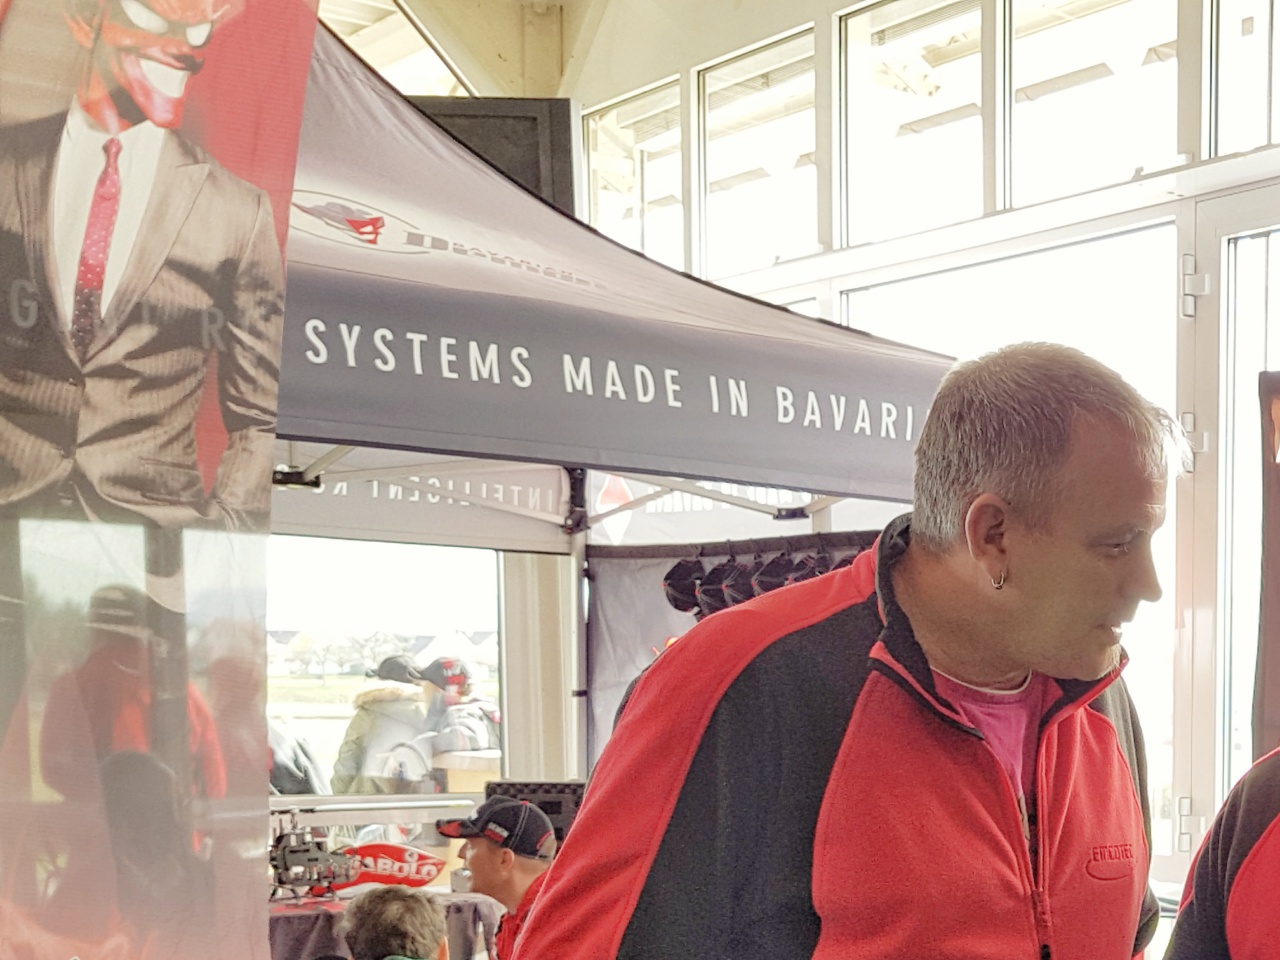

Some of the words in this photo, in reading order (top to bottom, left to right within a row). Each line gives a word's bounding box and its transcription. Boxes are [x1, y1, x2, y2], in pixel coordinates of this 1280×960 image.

[304, 318, 533, 388] SYSTEMS
[563, 353, 683, 408] MADE
[708, 374, 749, 418] IN
[776, 385, 915, 442] BAVARI
